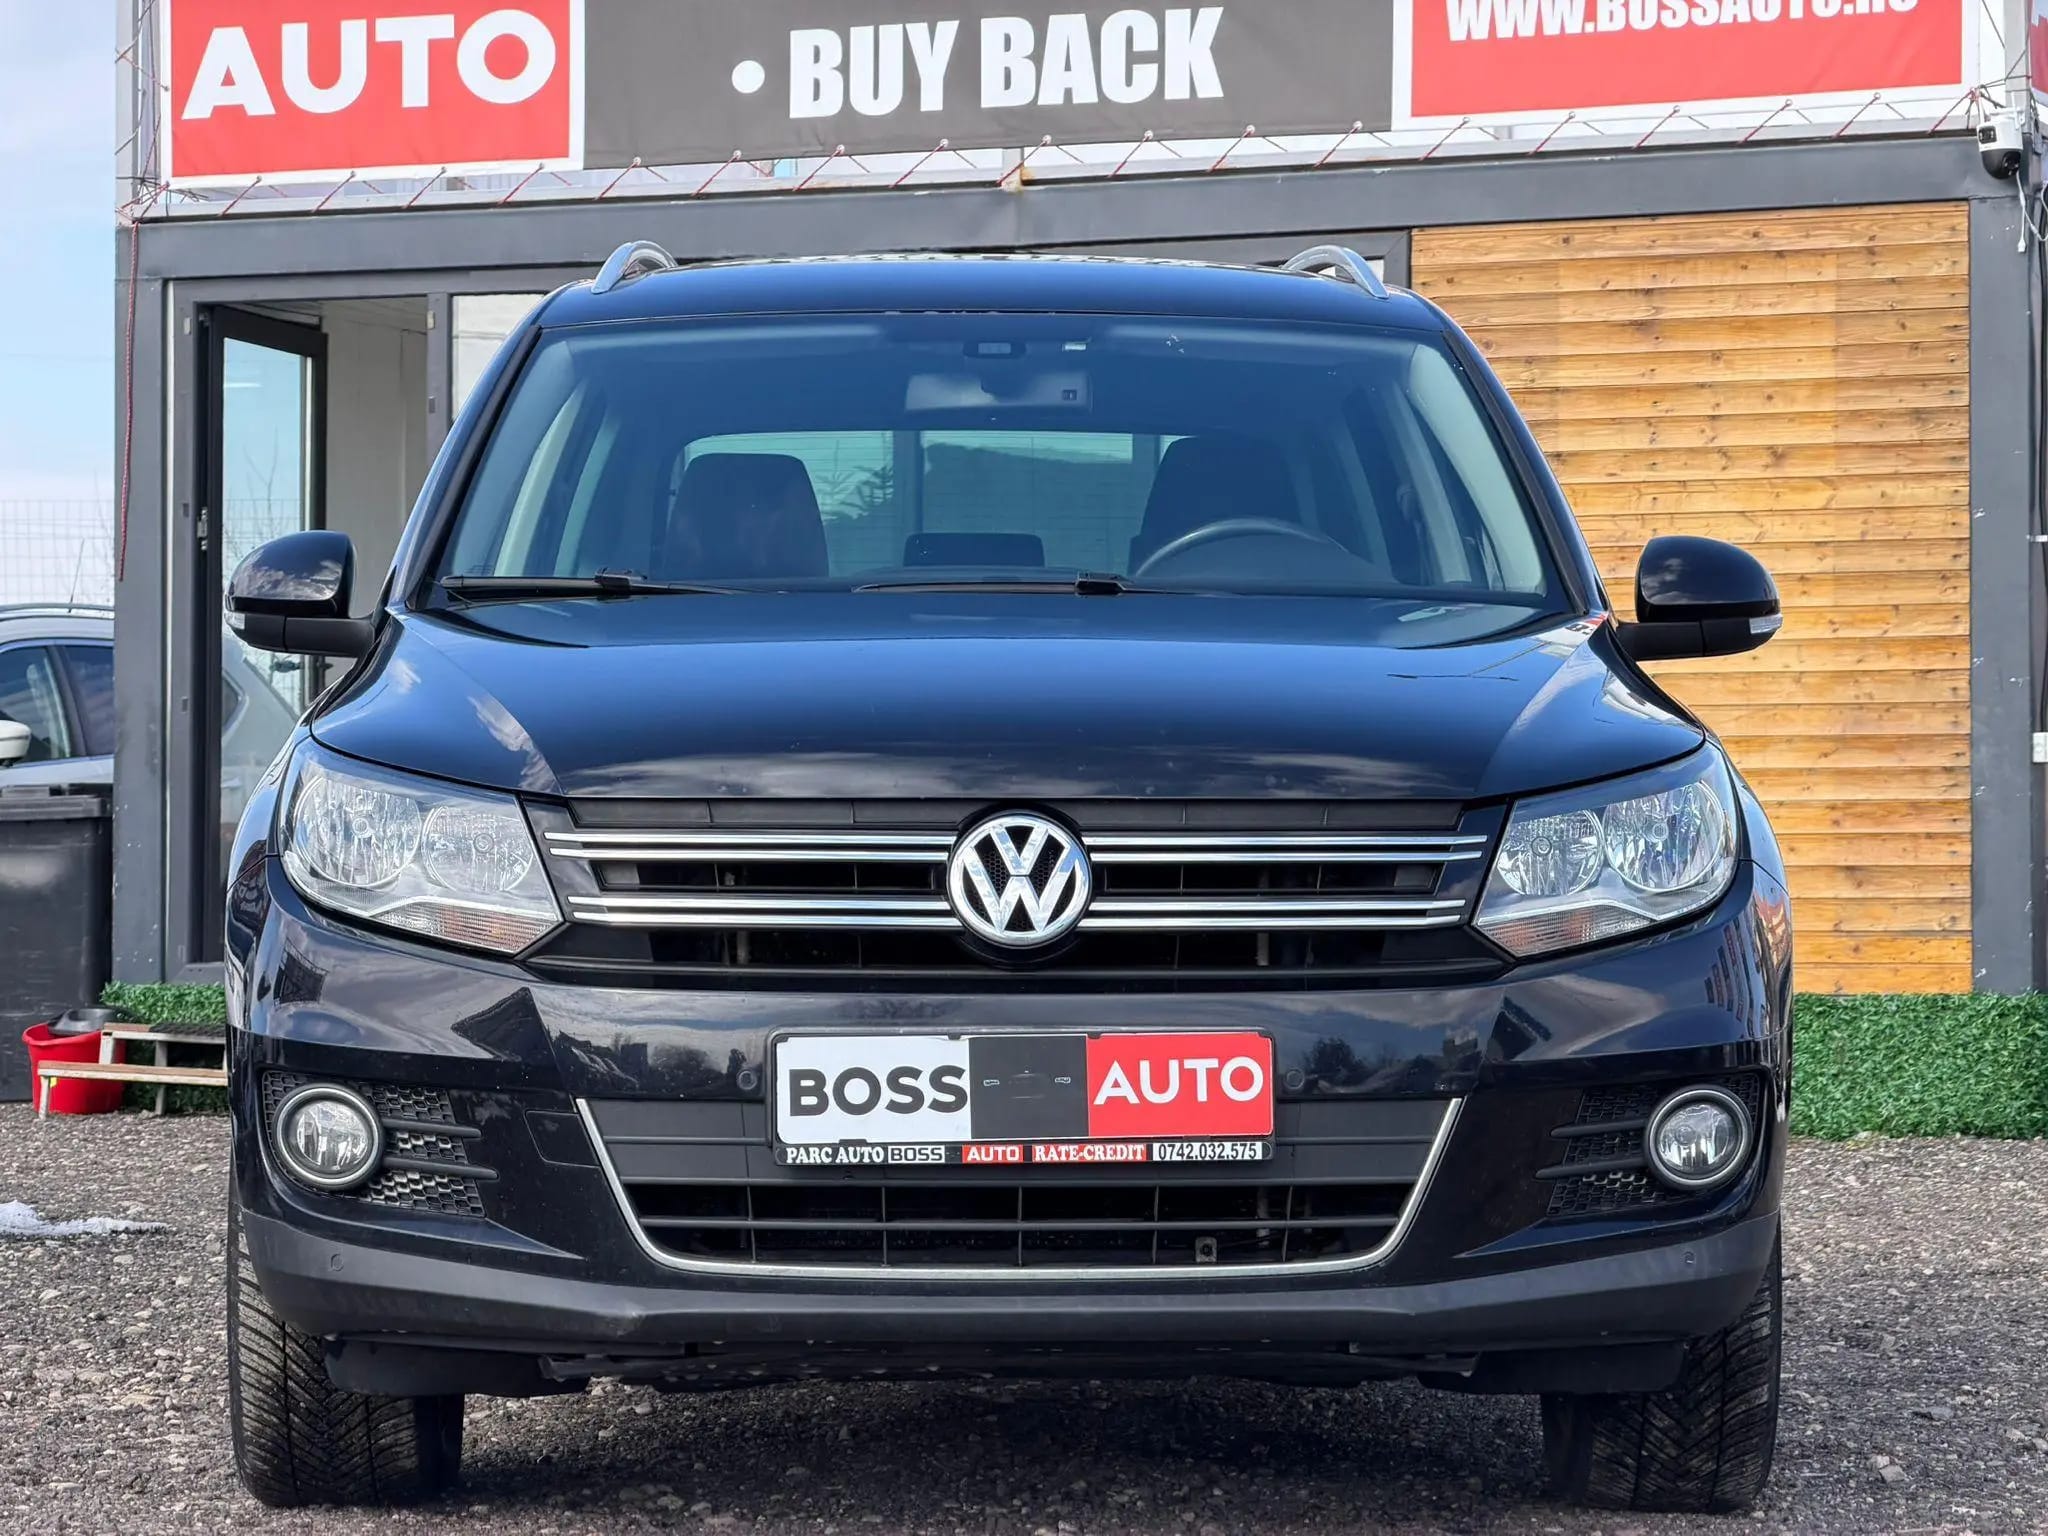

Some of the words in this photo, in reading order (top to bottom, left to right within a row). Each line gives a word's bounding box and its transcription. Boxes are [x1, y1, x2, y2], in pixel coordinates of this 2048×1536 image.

[1446, 0, 1919, 42] WWW.BOSS.
[181, 9, 557, 120] AUTO
[789, 20, 960, 119] BUY
[980, 6, 1225, 109] BACK
[788, 1064, 969, 1117] BOSS
[1093, 1055, 1265, 1106] AUTO
[786, 1145, 833, 1164] PARC
[835, 1145, 884, 1164] AUTO
[890, 1147, 944, 1163] BOSS
[966, 1146, 1020, 1162] AUTO
[1035, 1143, 1146, 1162] RATE-CREDIT
[1158, 1142, 1257, 1161] 0742.032.575
